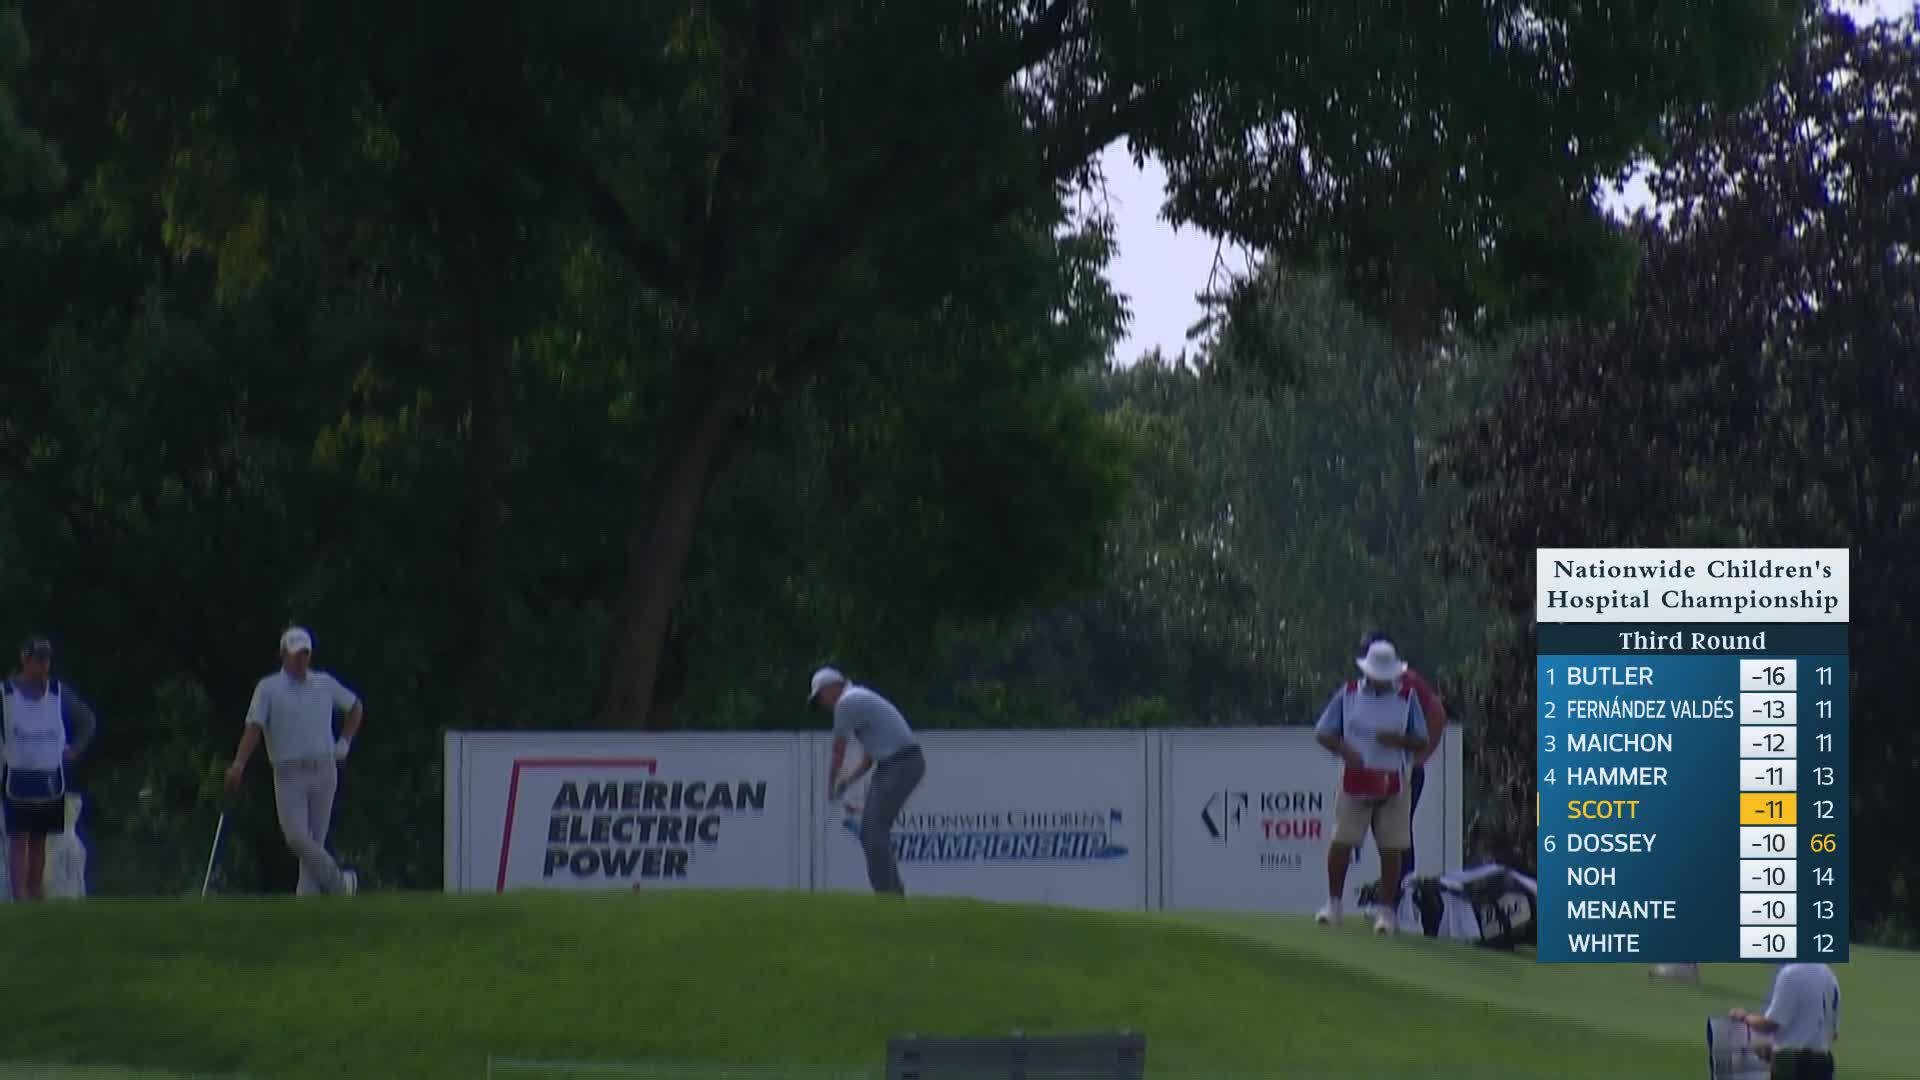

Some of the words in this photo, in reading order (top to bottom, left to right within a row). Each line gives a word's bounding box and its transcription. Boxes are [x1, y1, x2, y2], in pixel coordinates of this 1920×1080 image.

[552, 780, 767, 811] AMERICAN
[1260, 791, 1323, 812] KORN
[547, 815, 720, 843] ELECTRIC
[1262, 819, 1322, 839] TOUR
[543, 848, 688, 879] POWER
[1260, 853, 1302, 865] FINALS
